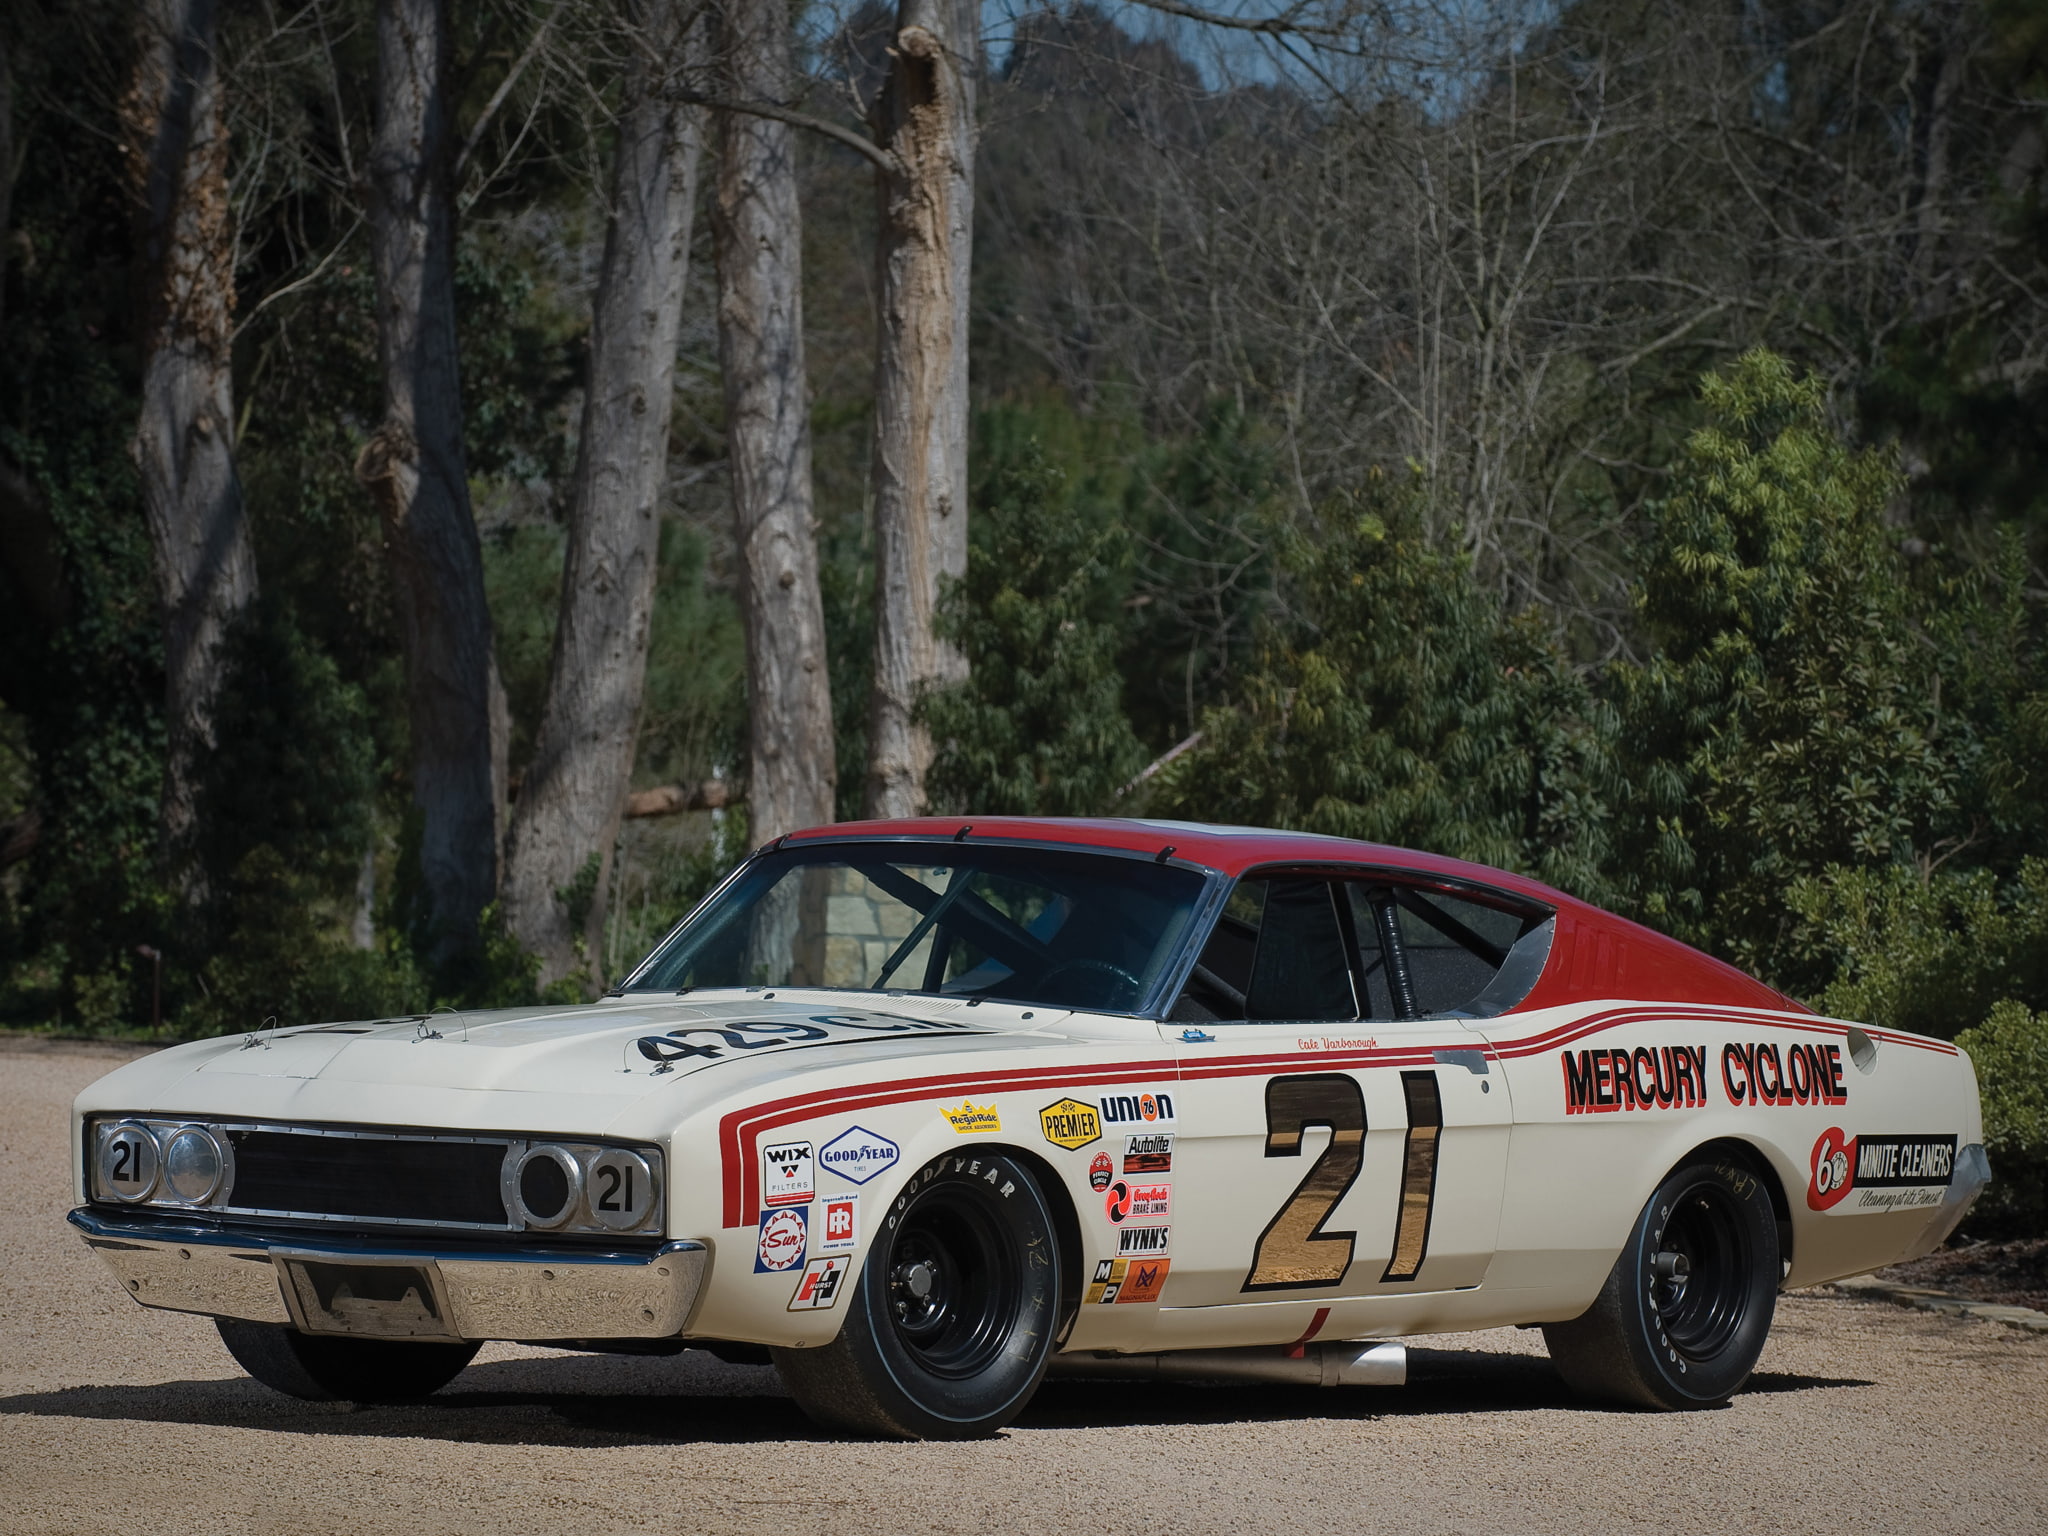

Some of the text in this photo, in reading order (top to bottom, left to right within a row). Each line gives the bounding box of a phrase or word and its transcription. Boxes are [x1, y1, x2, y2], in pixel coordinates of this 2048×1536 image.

[637, 1022, 829, 1062] 429
[1298, 1036, 1379, 1052] Cale Yarborough
[1561, 1043, 1847, 1115] MERCURY CYCLONE
[1045, 1113, 1097, 1138] PREMIER
[767, 1147, 811, 1163] WIX
[825, 1145, 894, 1162] GOODYEAR
[1129, 1136, 1170, 1153] Autolite
[112, 1140, 142, 1182] 21
[1858, 1145, 1899, 1178] MINUTE
[1900, 1143, 1953, 1177] CLEANERS
[596, 1164, 633, 1212] 21
[772, 1181, 808, 1191] FILTERS
[1240, 1070, 1444, 1293] 21
[1132, 1202, 1168, 1215] BRAKE LINING
[767, 1229, 799, 1248] Sun
[1120, 1227, 1168, 1251] WYNN'S
[809, 1281, 833, 1290] HURST
